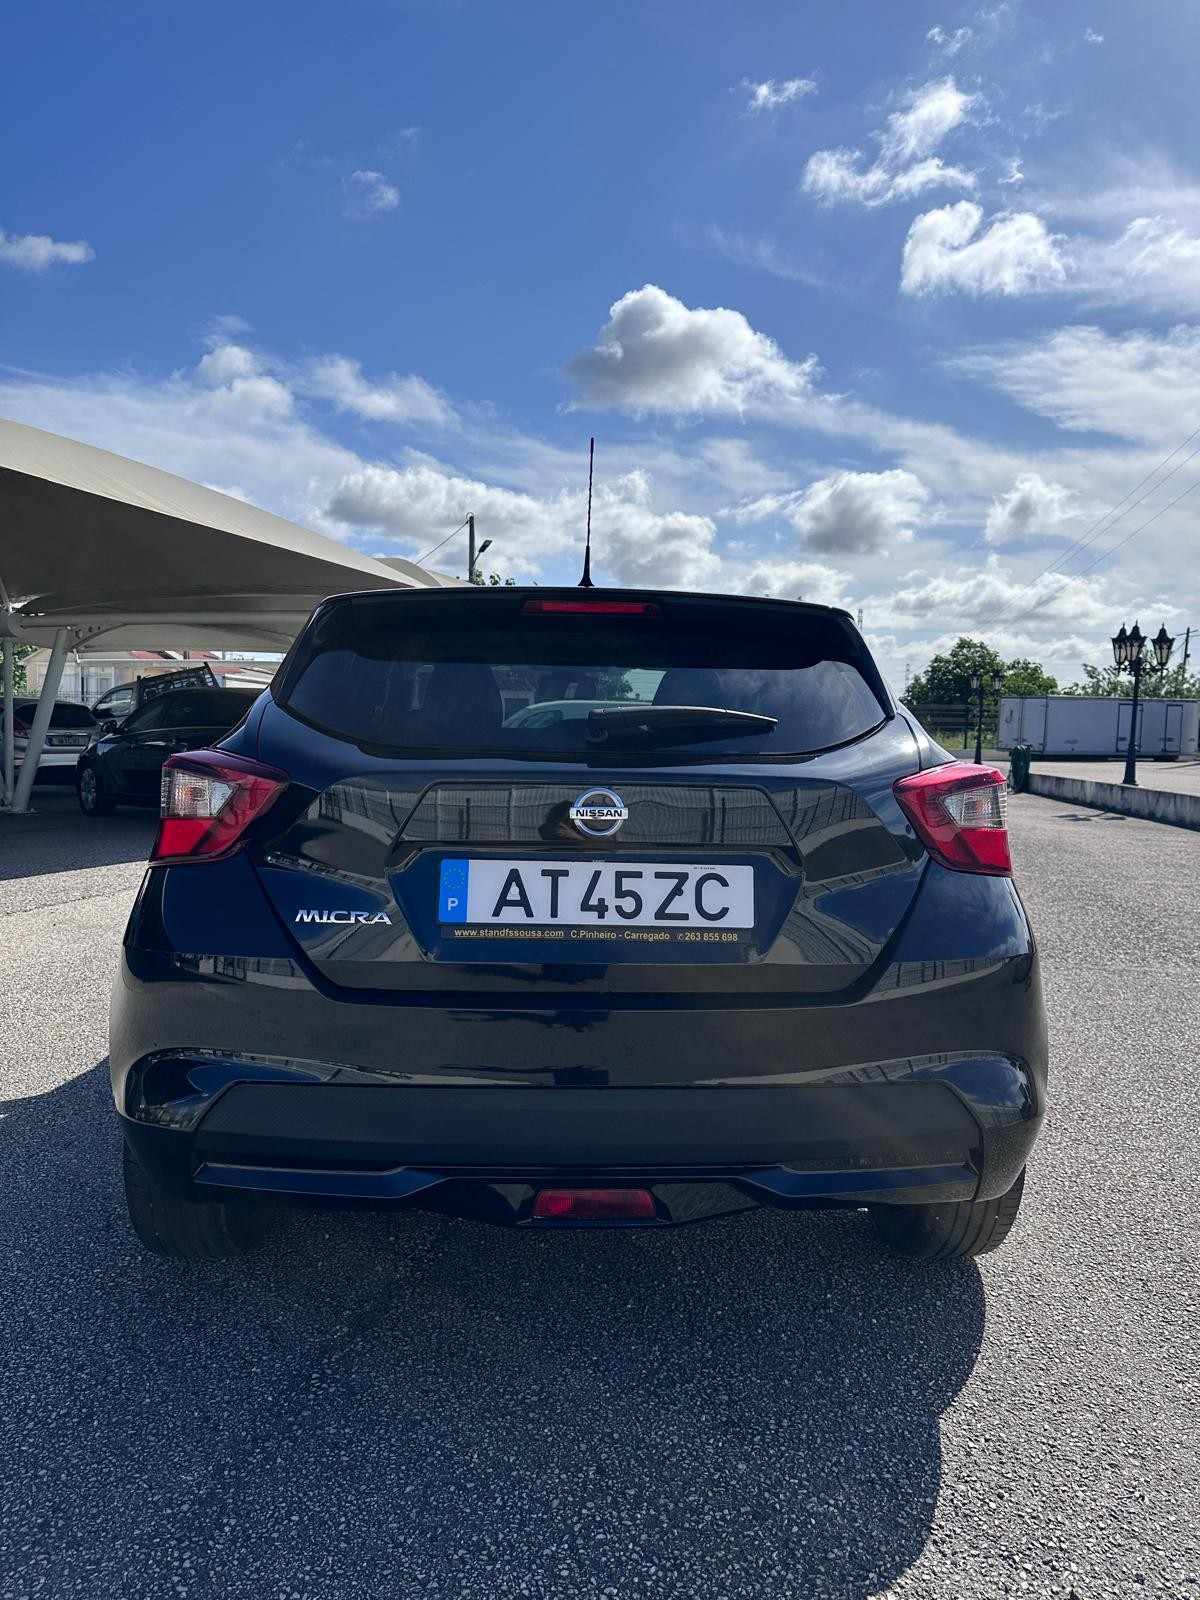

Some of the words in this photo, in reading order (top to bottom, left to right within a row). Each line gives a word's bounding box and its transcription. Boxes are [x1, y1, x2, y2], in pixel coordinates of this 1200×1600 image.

[576, 809, 623, 818] NISSAN
[447, 897, 459, 911] P
[295, 909, 393, 925] MICRA
[454, 927, 564, 939] www.standfssousa.com
[570, 929, 617, 939] C.Pinheiro
[624, 931, 670, 942] Carregado
